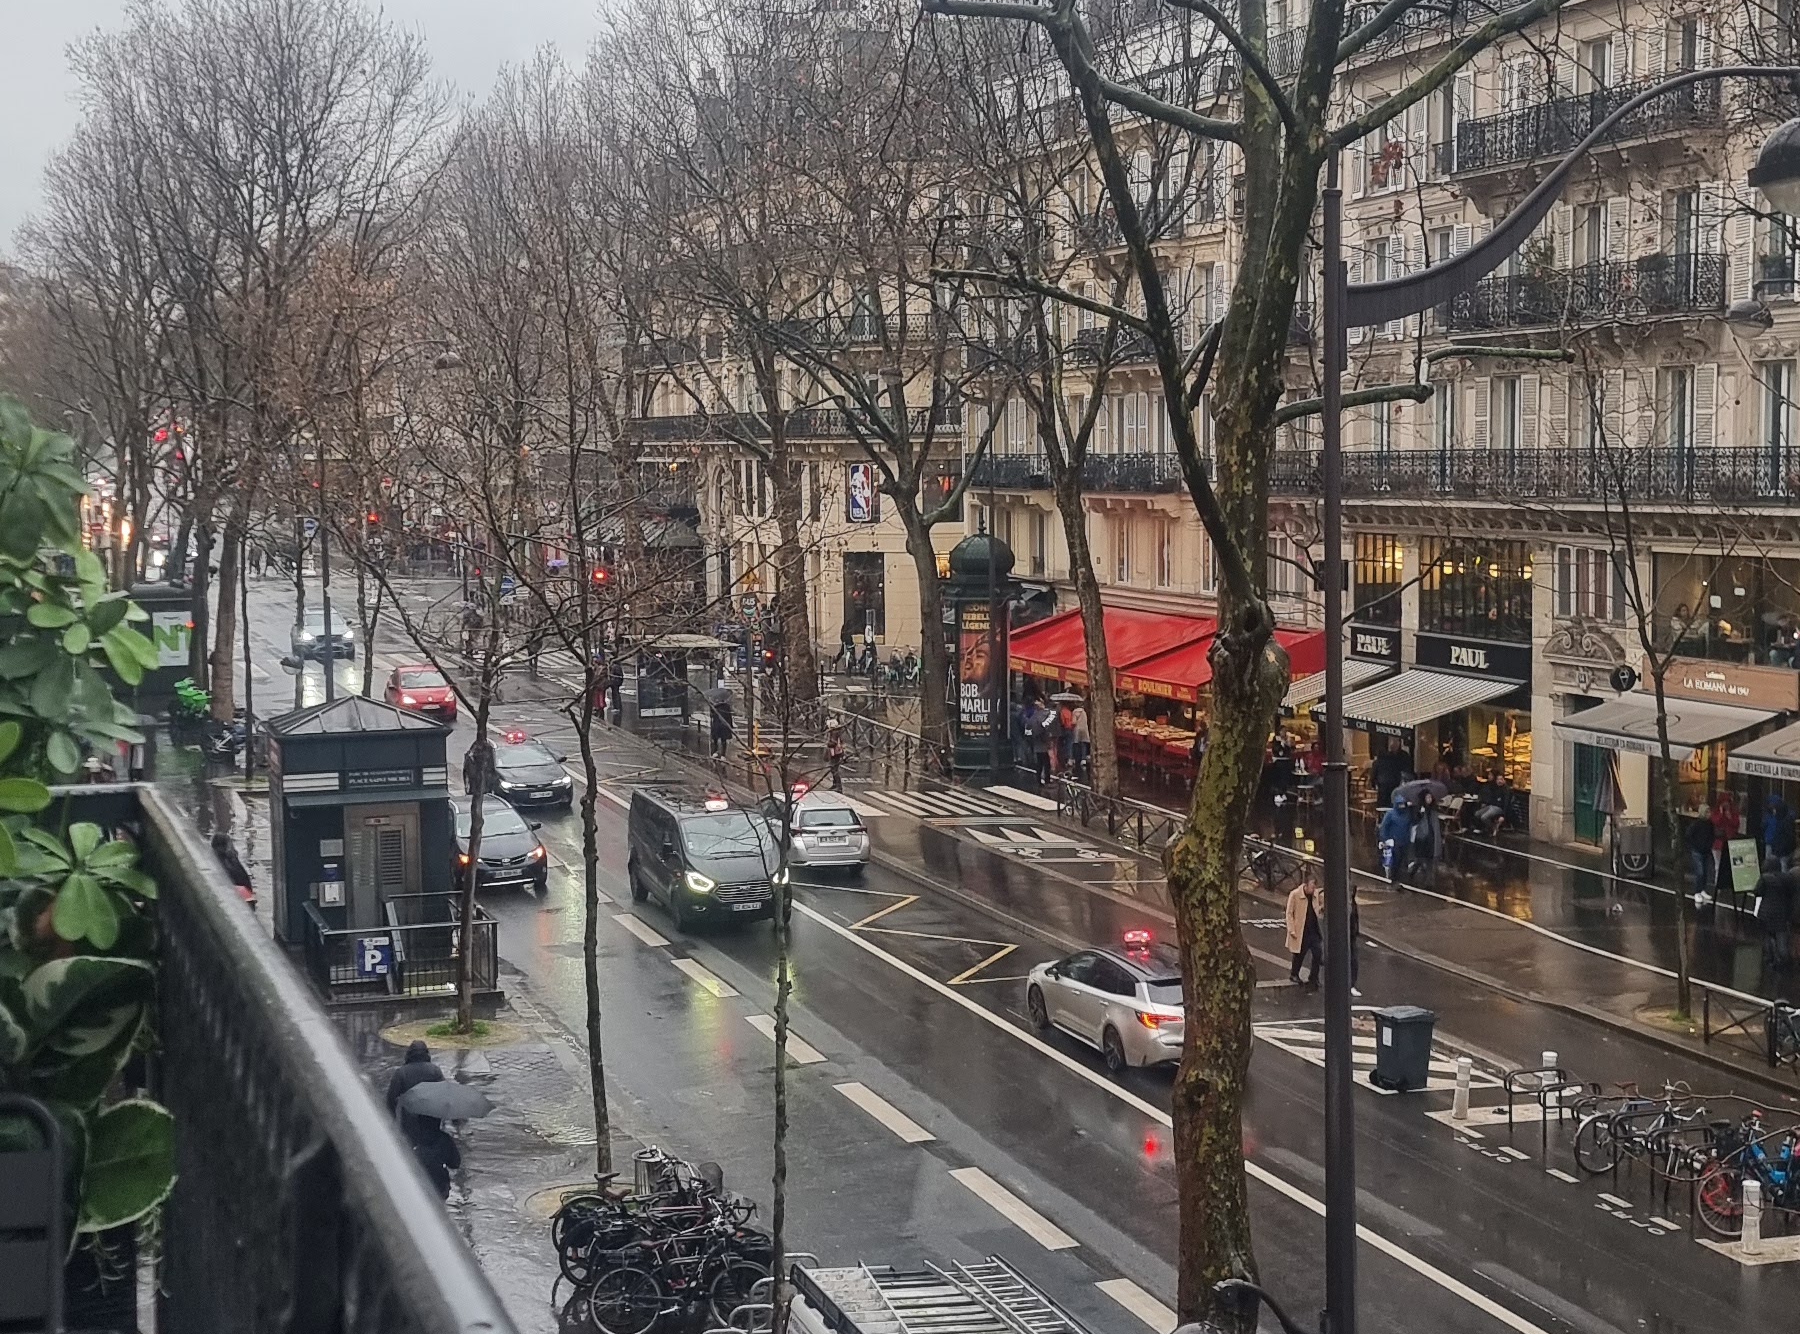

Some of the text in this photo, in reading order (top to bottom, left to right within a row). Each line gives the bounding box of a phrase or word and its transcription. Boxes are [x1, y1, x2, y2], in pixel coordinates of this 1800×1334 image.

[1356, 633, 1392, 656] PAUL
[1449, 645, 1490, 670] PAUL
[960, 682, 979, 698] BOB
[1683, 677, 1694, 689] LA
[960, 697, 1000, 713] MARL
[971, 713, 989, 723] LOVE
[364, 949, 382, 972] P
